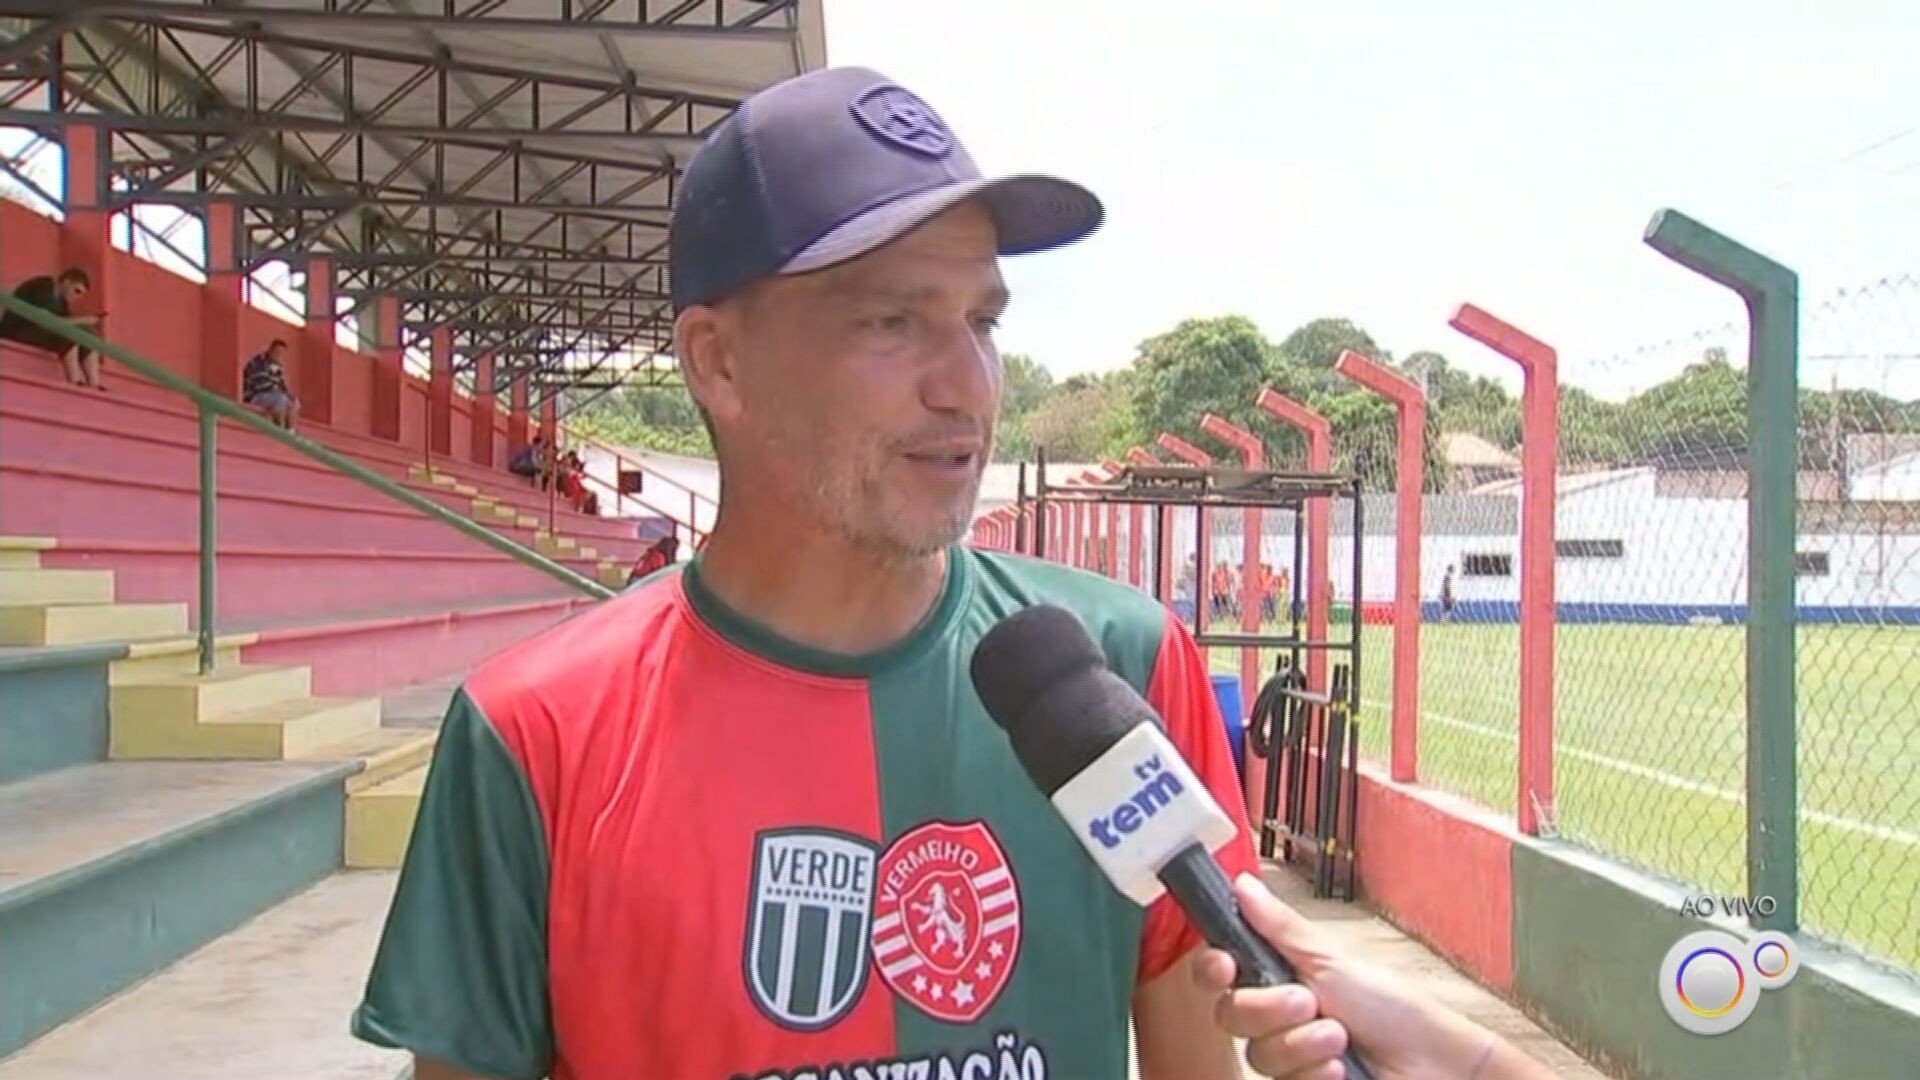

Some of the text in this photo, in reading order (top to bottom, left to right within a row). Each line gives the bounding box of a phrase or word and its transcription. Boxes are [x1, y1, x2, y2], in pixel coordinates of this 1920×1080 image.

[1133, 754, 1162, 780] tv
[1089, 771, 1185, 848] tem
[768, 845, 869, 892] VERDE
[733, 1033, 1046, 1080] IZAÇÃO
